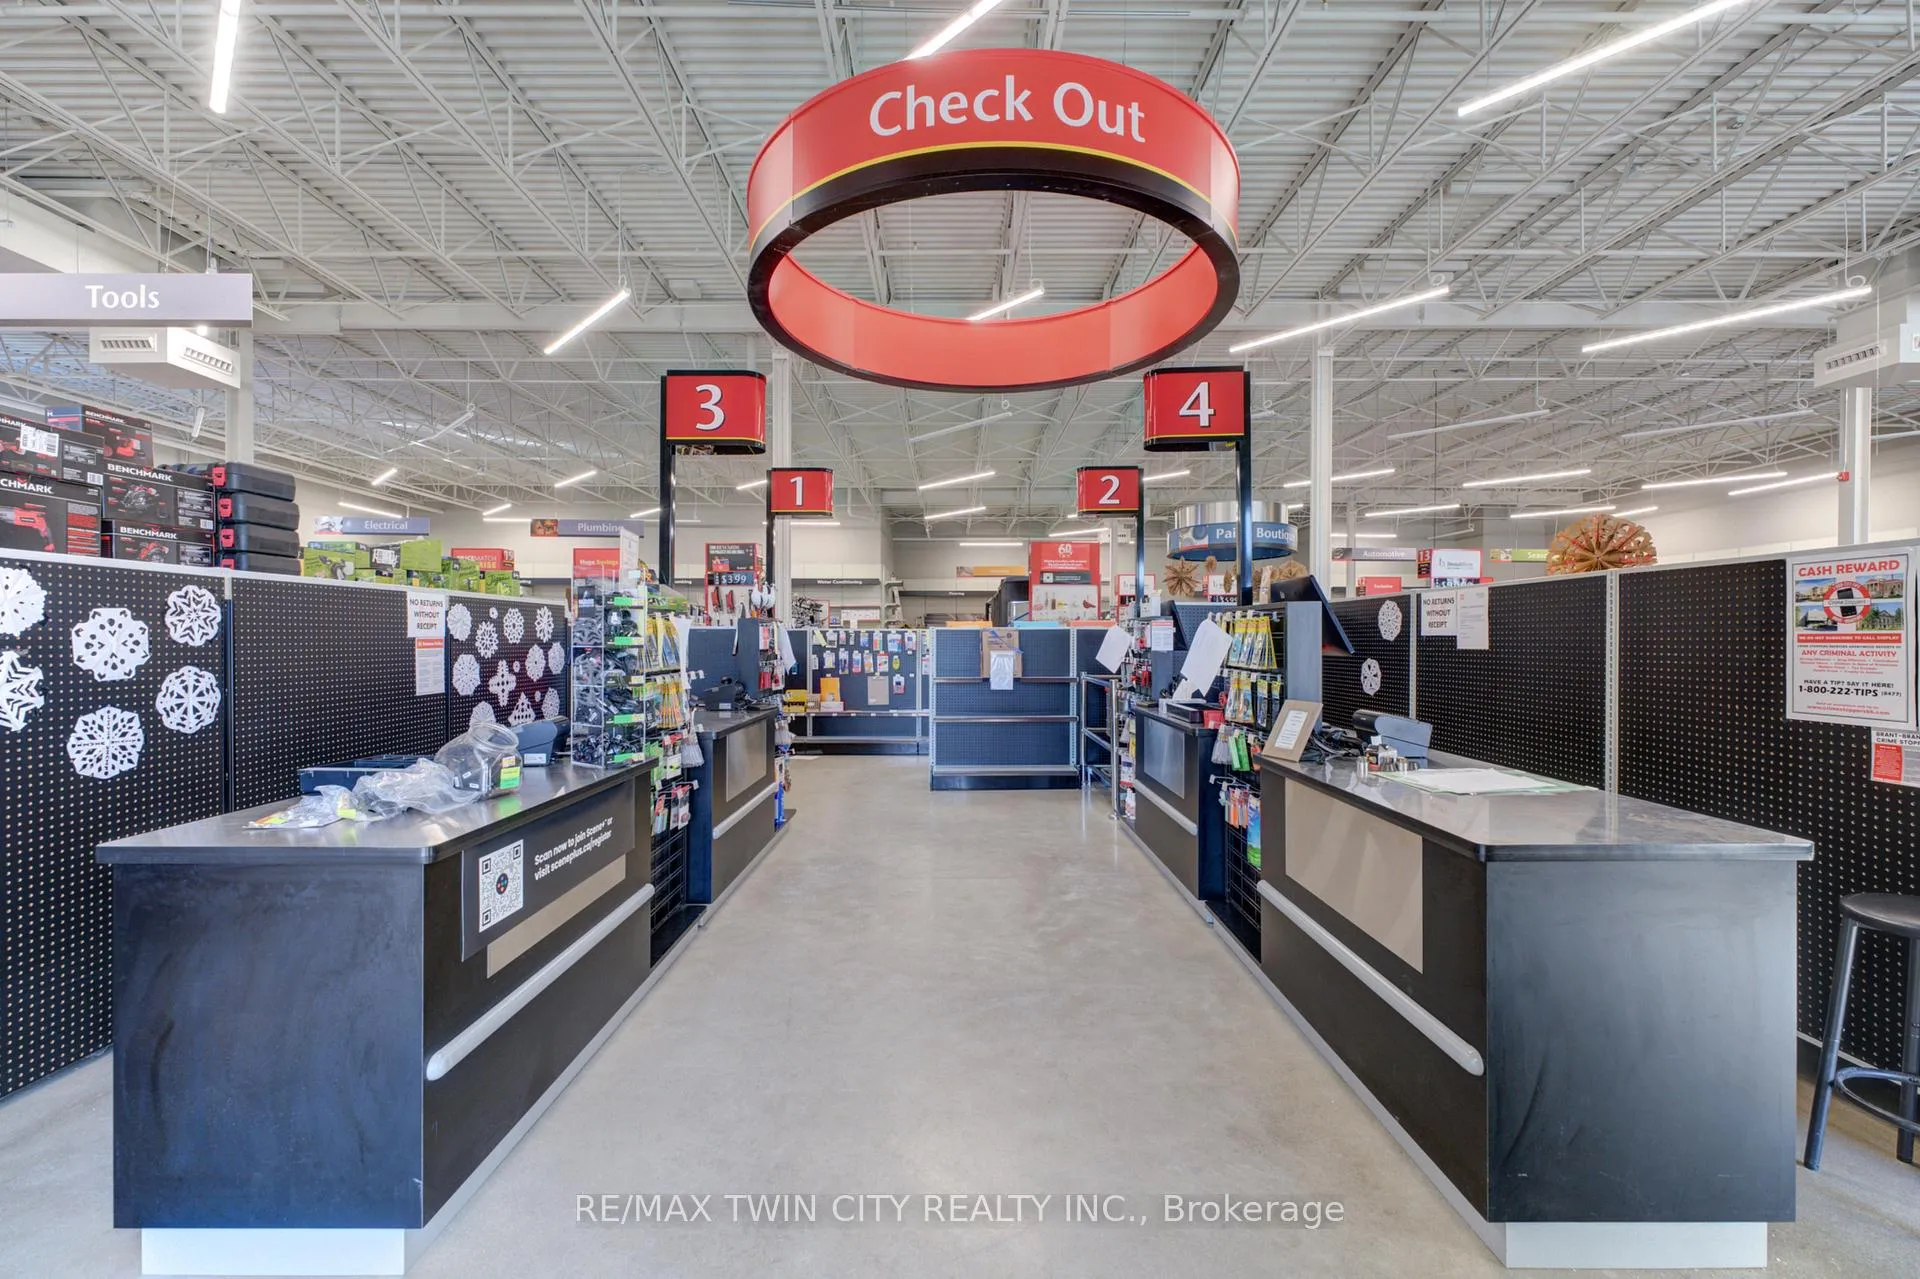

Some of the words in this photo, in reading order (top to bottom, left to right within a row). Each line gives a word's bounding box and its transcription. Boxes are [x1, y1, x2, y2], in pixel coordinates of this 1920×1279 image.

[869, 75, 1034, 137] Check
[1053, 81, 1146, 143] Out
[85, 284, 160, 309] Tools
[695, 383, 725, 431] 3
[1178, 381, 1215, 428] 4
[85, 410, 125, 423] BENCHMARK
[107, 463, 173, 481] BENCHMARK
[789, 476, 804, 507] 1
[1098, 474, 1121, 505] 2
[364, 519, 409, 530] Electrical
[120, 526, 177, 540] BENCHMARK
[1216, 527, 1236, 539] Pai
[1363, 550, 1406, 558] Automotive
[1418, 550, 1431, 562] 13
[1798, 564, 1832, 577] CASH
[1836, 559, 1900, 575] REWARD
[1432, 597, 1455, 605] RETURNS
[1427, 609, 1450, 617] WITHOUT
[417, 622, 437, 630] RECEIPT
[1819, 649, 1857, 657] CRIMINAL
[1859, 650, 1897, 658] ACTIVITY
[1799, 685, 1878, 697] 1-800-222-TIPS
[535, 850, 553, 866] Scan
[553, 841, 567, 855] now
[567, 838, 575, 848] to
[574, 831, 586, 847] join
[534, 864, 550, 880] visit
